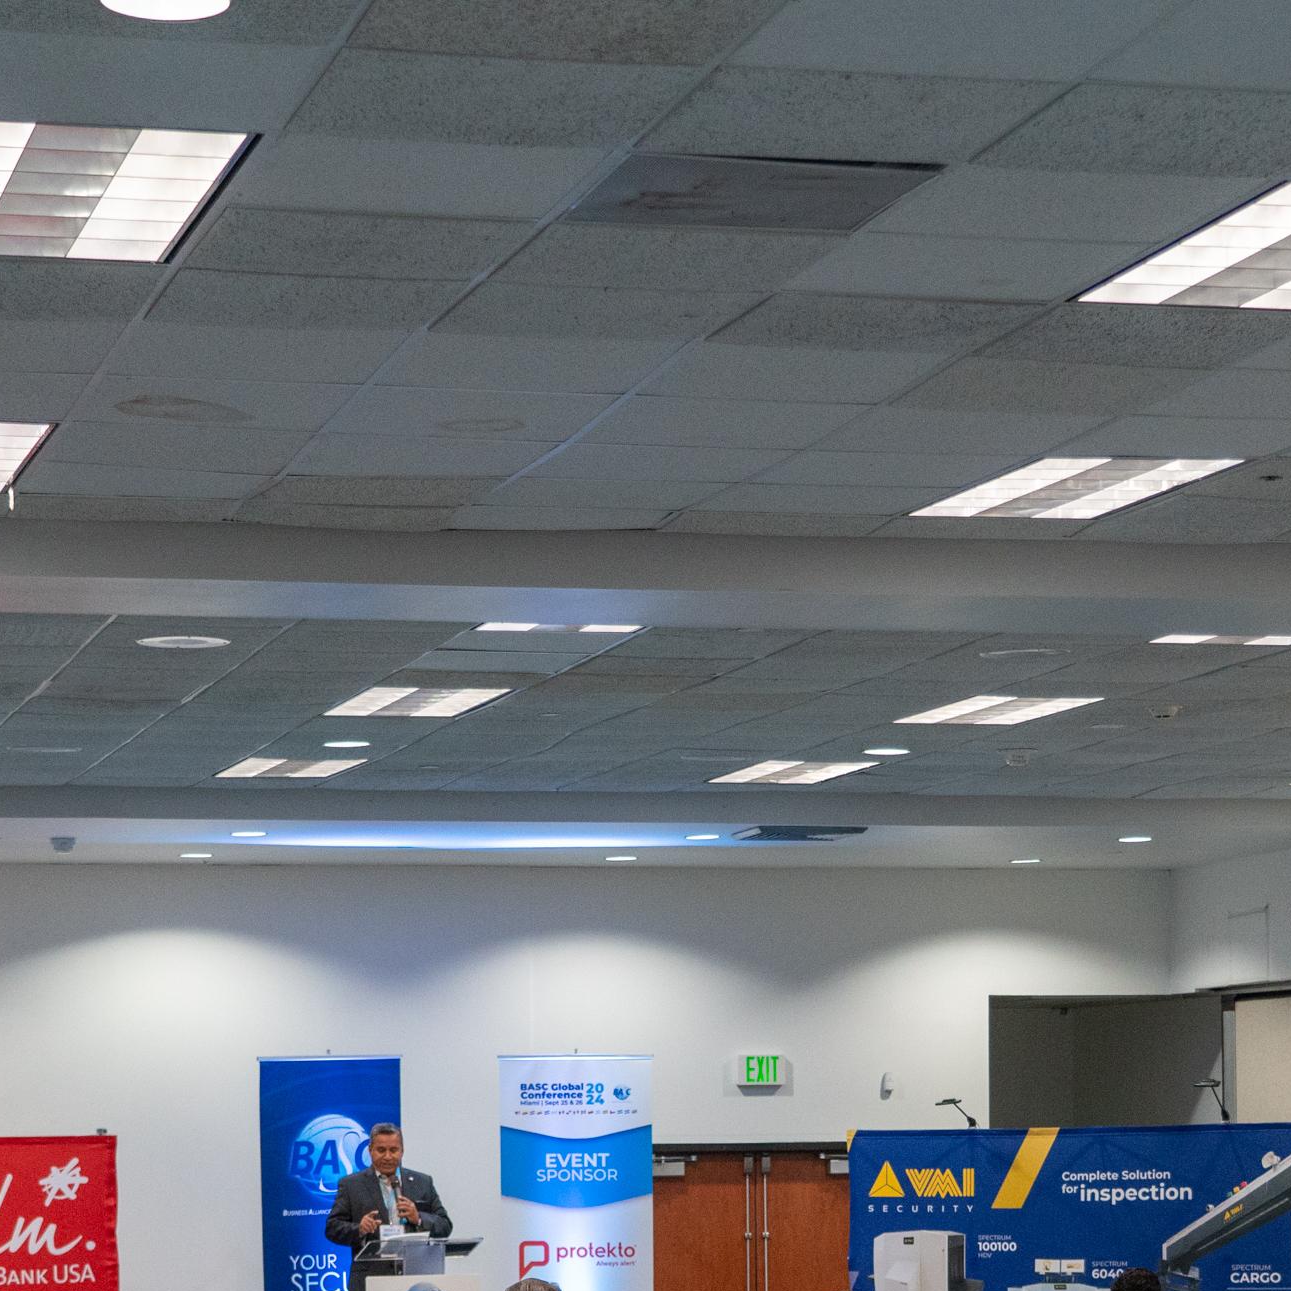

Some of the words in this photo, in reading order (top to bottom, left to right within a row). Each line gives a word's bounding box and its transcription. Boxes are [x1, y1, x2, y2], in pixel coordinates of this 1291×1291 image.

[746, 1055, 780, 1084] EXIT
[519, 1083, 549, 1091] BASC
[550, 1082, 584, 1091] Global
[585, 1082, 605, 1094] 20
[519, 1091, 584, 1100] Conference
[585, 1094, 606, 1105] 24
[544, 1152, 610, 1169] EVENT
[536, 1168, 618, 1182] SPONSOR
[1061, 1170, 1119, 1184] Complete
[1121, 1169, 1171, 1181] Solution
[905, 1167, 976, 1199] VMI
[1061, 1183, 1079, 1194] for
[1080, 1182, 1194, 1206] inspection
[867, 1204, 975, 1213] SECURITY
[556, 1242, 636, 1263] protekto
[977, 1241, 1018, 1252] 100100
[289, 1253, 338, 1271] YOUR
[1091, 1260, 1129, 1268] SPECTRUM
[1231, 1263, 1272, 1271] SPECTRUM
[53, 1263, 97, 1284] USA
[1229, 1272, 1282, 1284] CARGO
